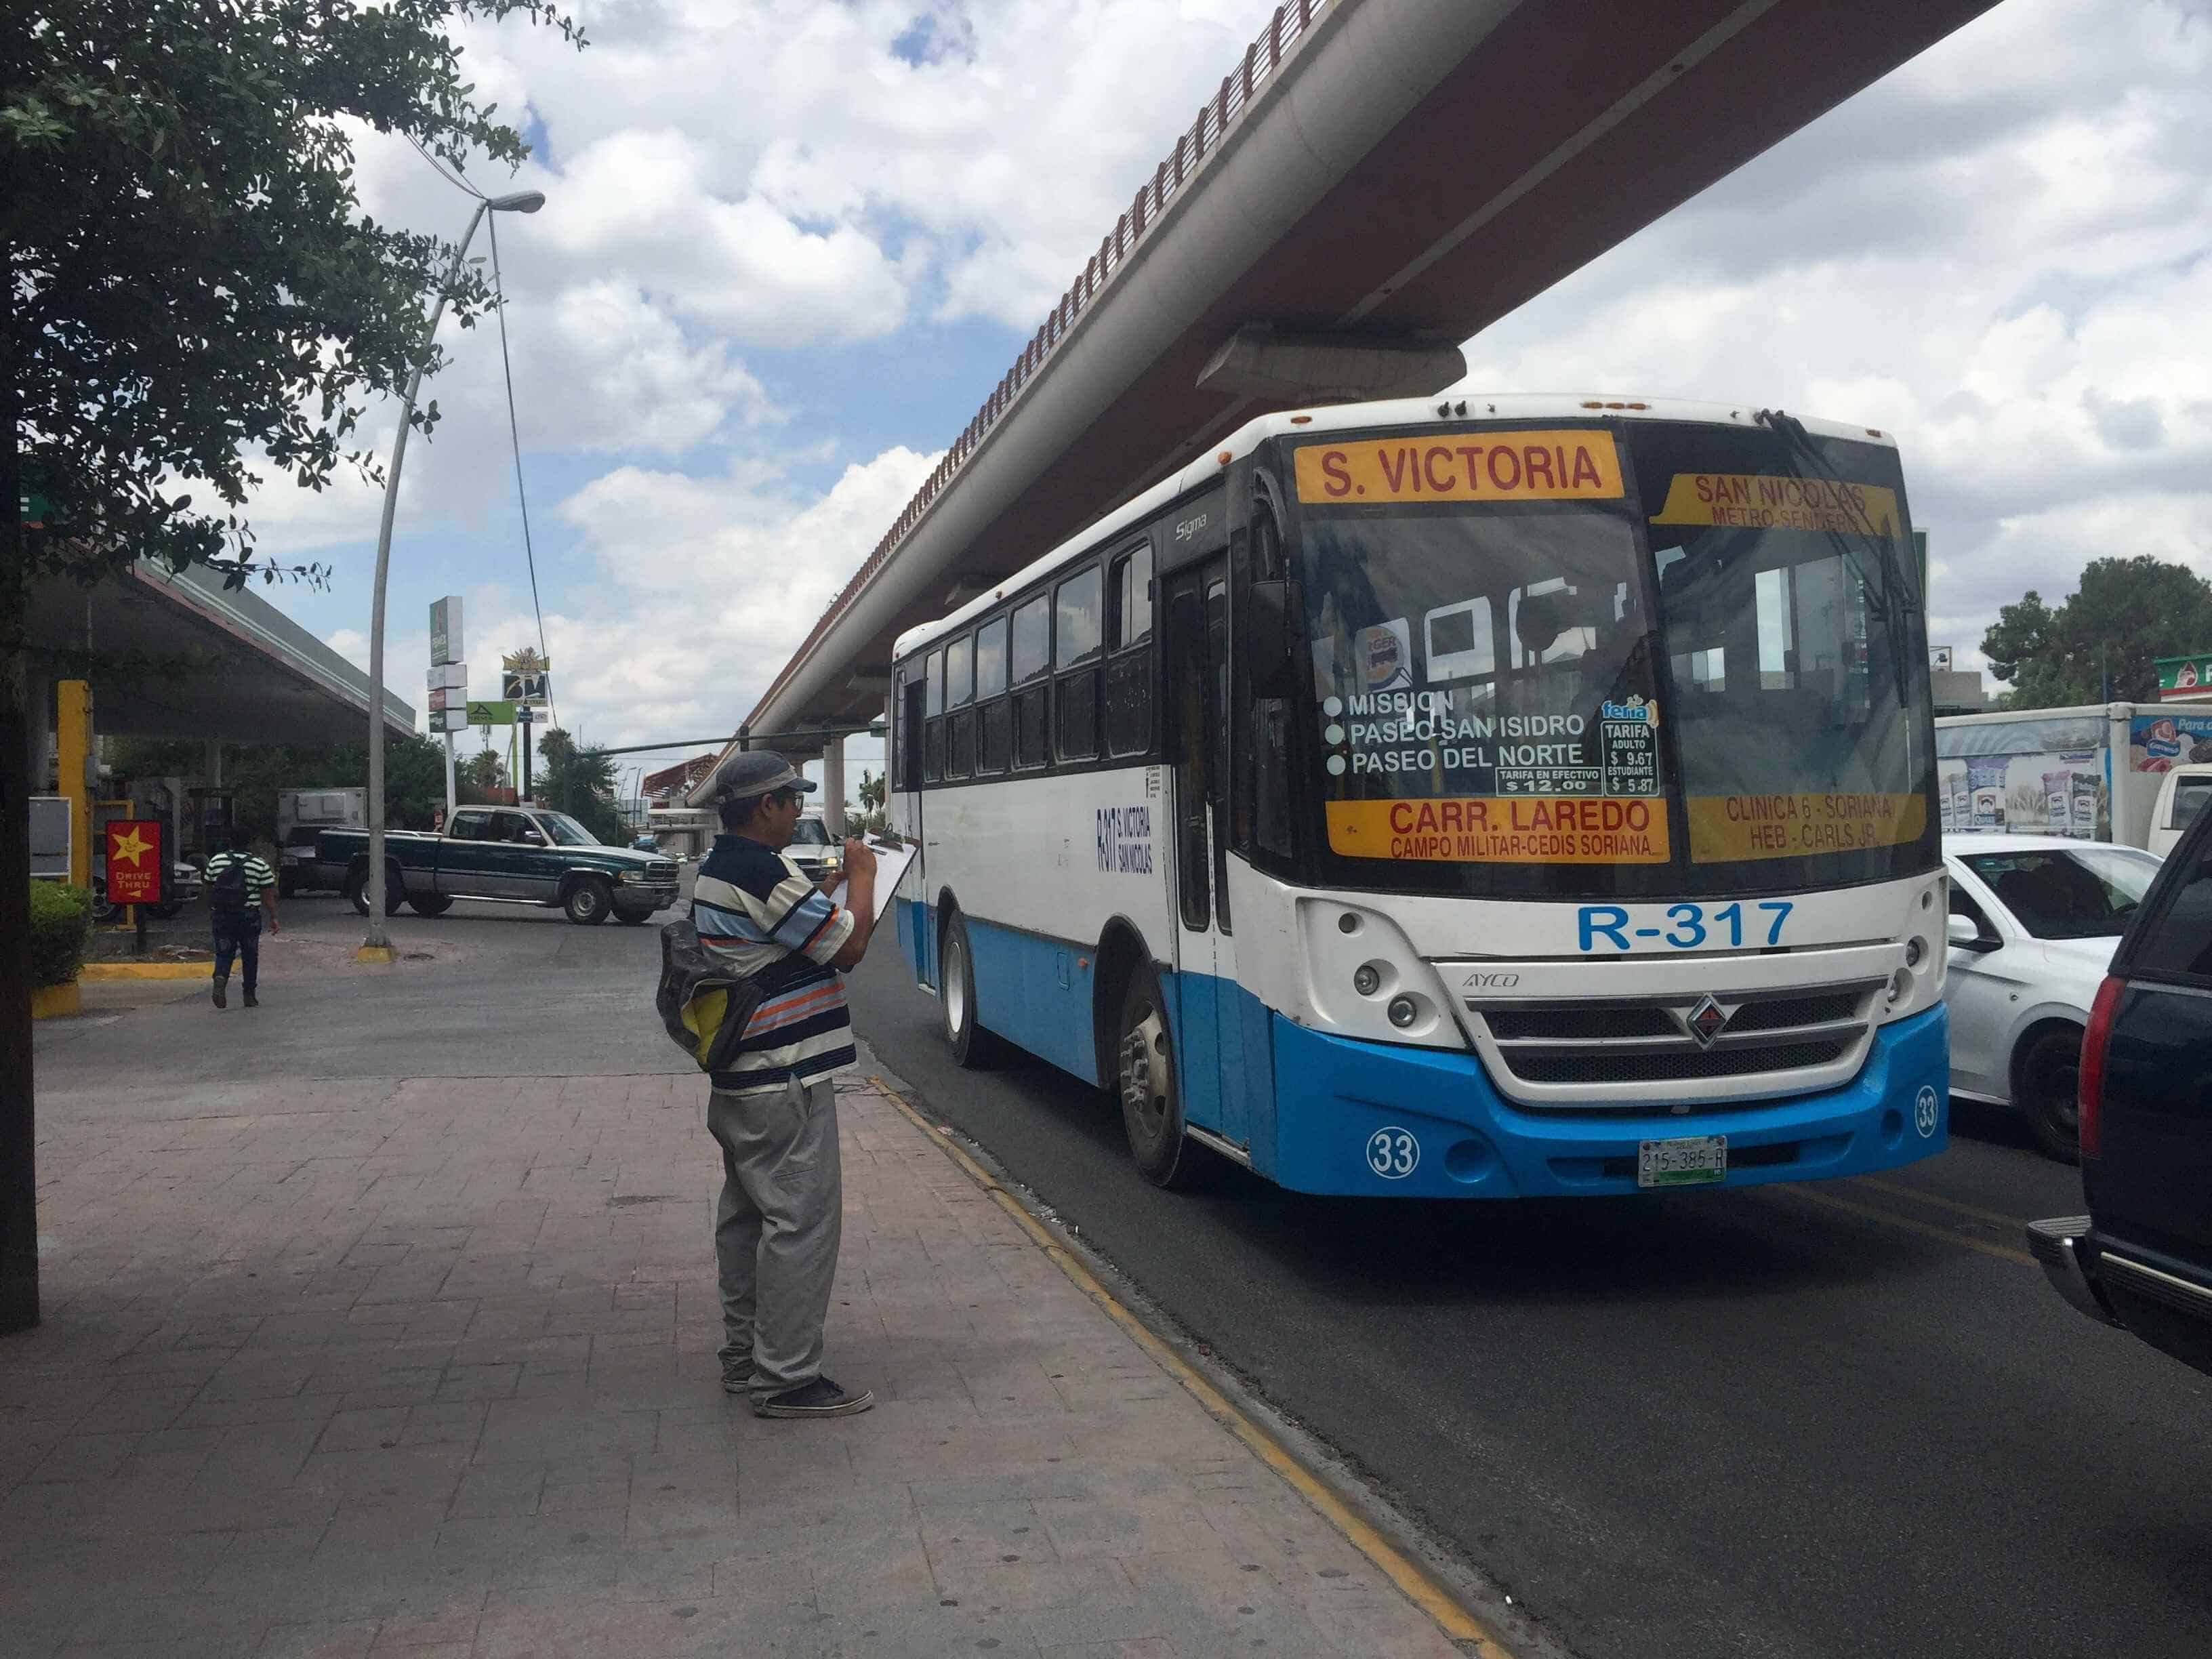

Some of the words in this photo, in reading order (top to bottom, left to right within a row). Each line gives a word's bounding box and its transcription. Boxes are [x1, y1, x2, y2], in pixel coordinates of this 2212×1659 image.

[1322, 451, 1366, 497] S.
[1378, 445, 1603, 493] VICTORIA
[1696, 476, 1752, 505] SAN
[1757, 478, 1865, 510] NICOLAS
[1175, 514, 1207, 541] Sigma
[1349, 691, 1454, 715] MISSION
[1350, 719, 1434, 744] PASEO
[1441, 716, 1492, 740] SAN
[1500, 714, 1584, 737] ISIDRO
[1605, 724, 1650, 739] TARIFA
[1612, 739, 1645, 750] ADULTO
[1352, 749, 1437, 773] PASEO
[1443, 747, 1493, 770] DEL
[1498, 743, 1584, 766] NORTE
[1611, 751, 1618, 766] $
[1626, 752, 1653, 766] 9.67
[1500, 771, 1534, 780] TARIFA
[1536, 771, 1549, 779] EN
[1553, 771, 1599, 779] EFECTIVO
[1607, 766, 1654, 777] ESTUDIANTE
[1612, 777, 1620, 792] $
[1627, 778, 1654, 792] 5.87
[1506, 780, 1519, 792] $
[1523, 780, 1586, 792] 12.00
[1389, 801, 1498, 834] CARR.
[1511, 800, 1650, 832] LAREDO
[1726, 796, 1798, 821] CLINICA
[1802, 797, 1811, 819] 6
[1824, 796, 1893, 820] SORIANA
[1122, 806, 1151, 838] VICTORIA
[1391, 836, 1452, 858] CAMPO
[1458, 835, 1576, 857] MILITAR-CEDIS
[1581, 835, 1651, 856] SORIANA
[1750, 825, 1787, 850] HEB
[1801, 823, 1855, 848] CARLS
[1859, 823, 1881, 847] JR.
[1118, 844, 1129, 874] SAN
[1129, 844, 1152, 874] NICOLAS
[116, 872, 152, 880] DRIVE
[117, 881, 150, 889] THRU
[1577, 902, 1794, 951] R-317
[1919, 1095, 1934, 1128] 33
[1373, 1133, 1412, 1173] 33
